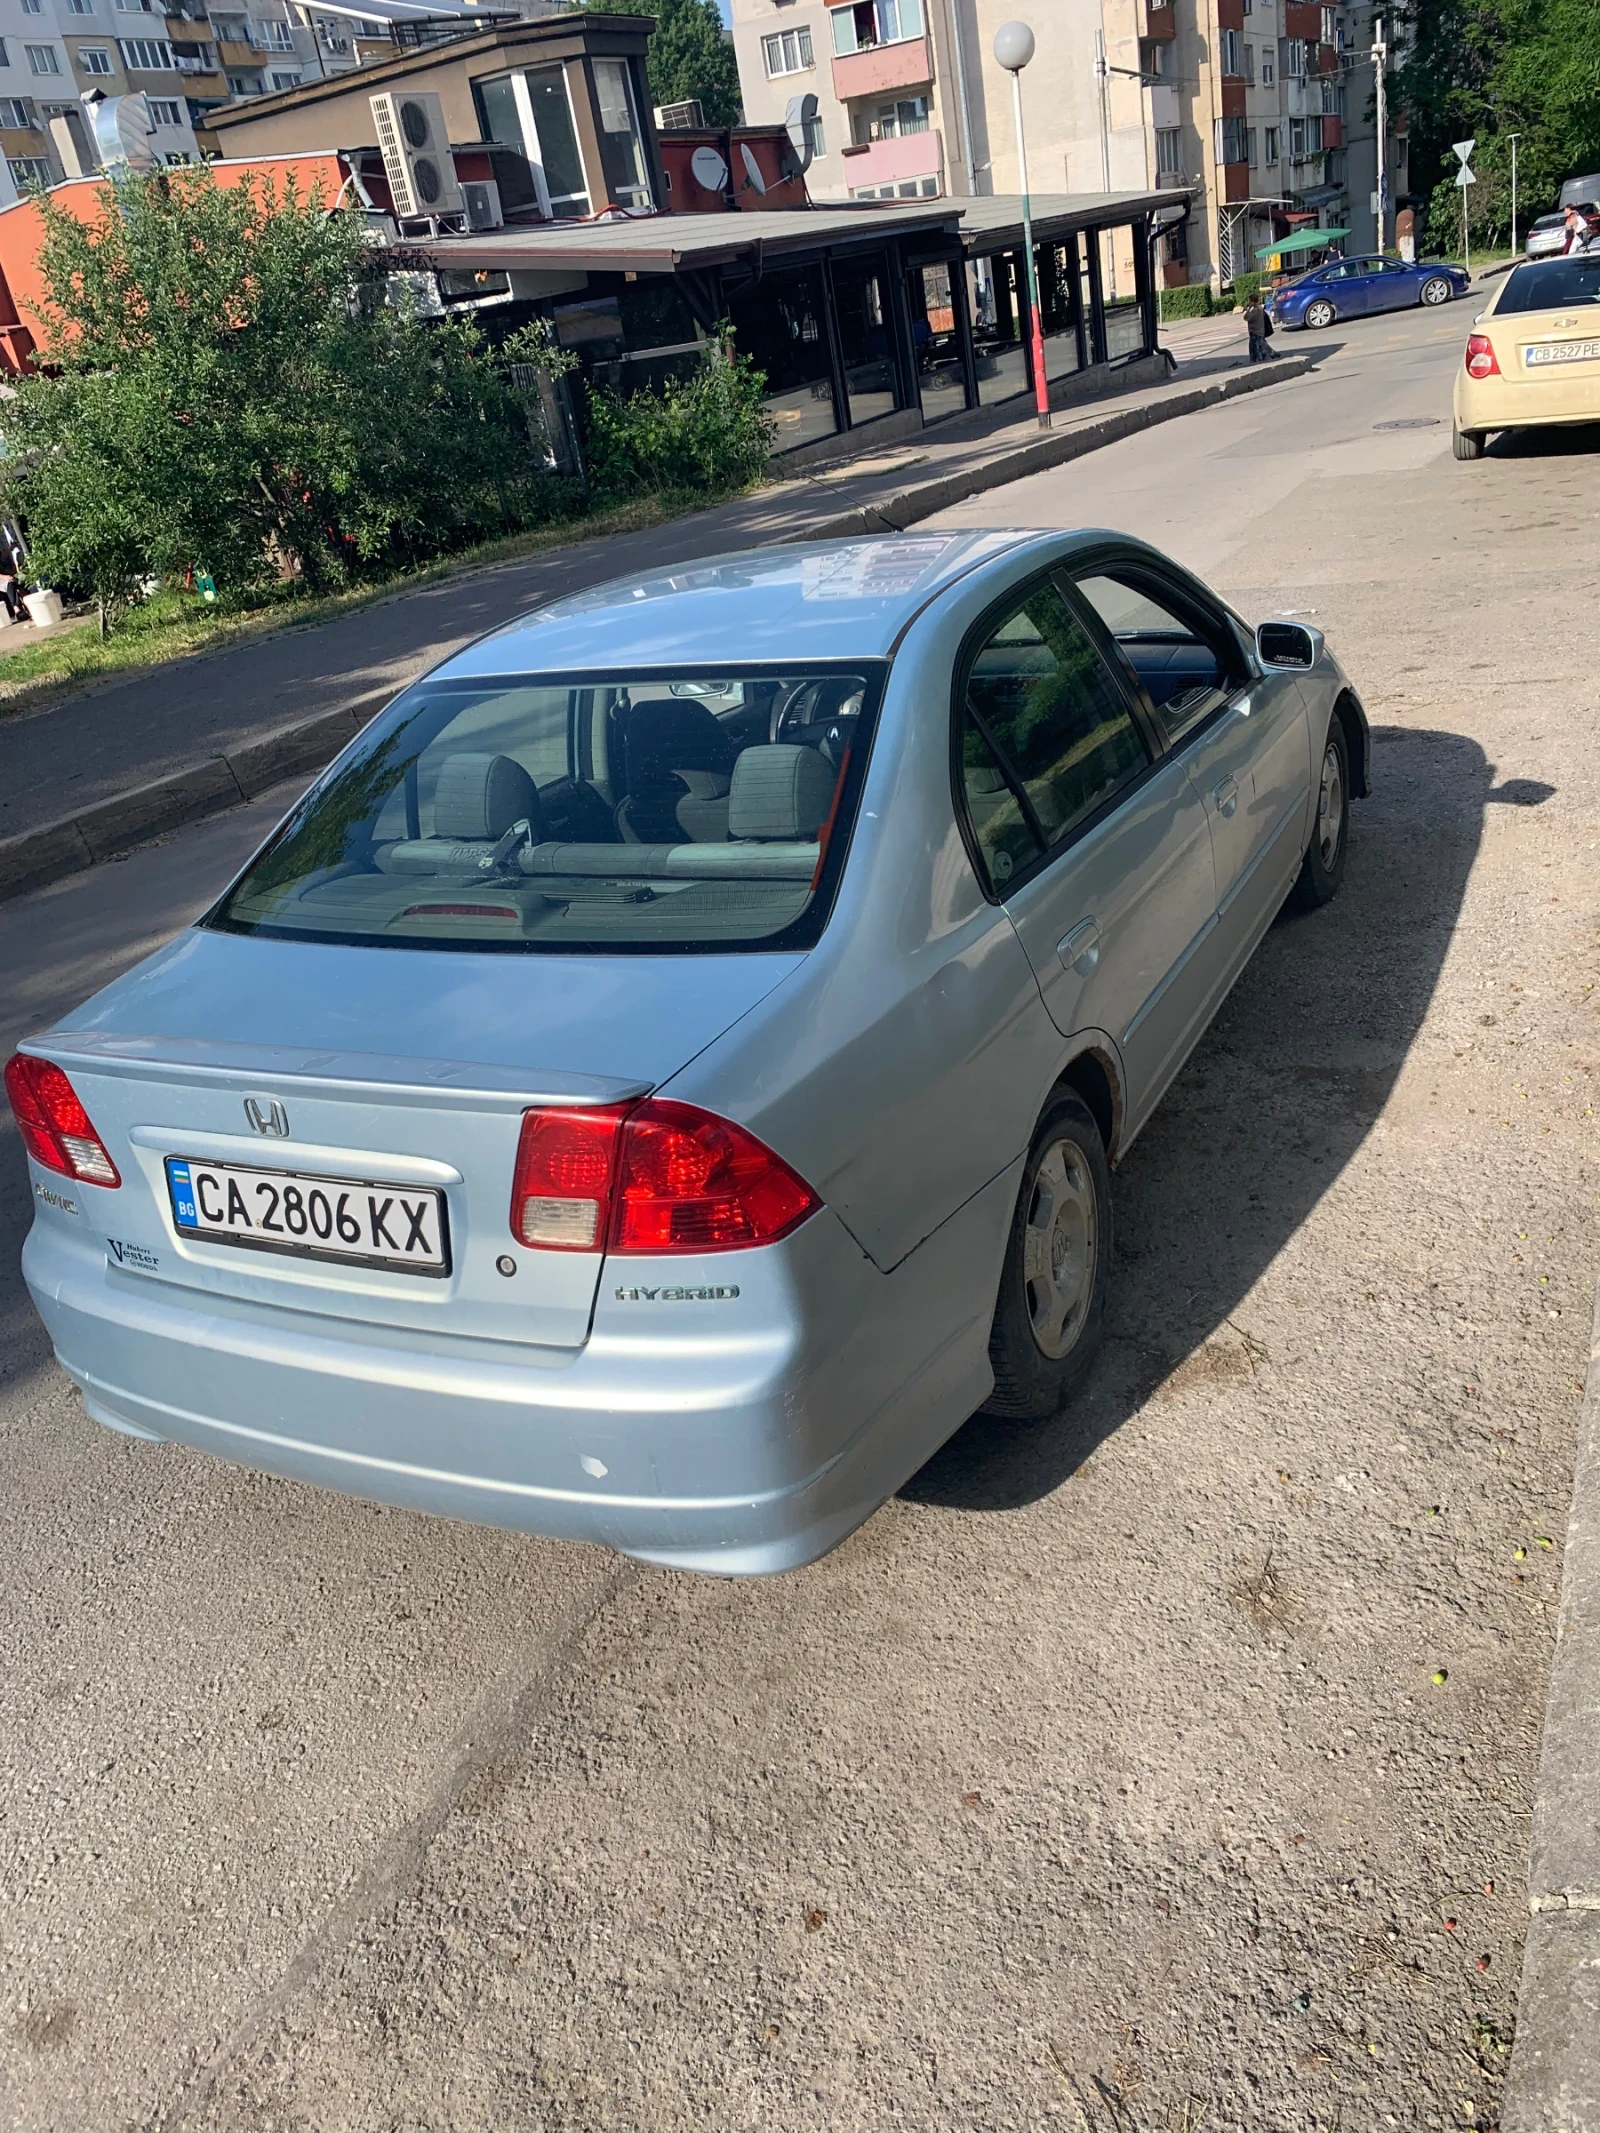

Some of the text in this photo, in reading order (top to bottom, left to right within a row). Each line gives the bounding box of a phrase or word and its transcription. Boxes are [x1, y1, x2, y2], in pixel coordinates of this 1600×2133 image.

[1552, 345, 1582, 360] 2527
[178, 1201, 195, 1217] BG
[106, 1237, 160, 1265] Vester
[614, 1284, 740, 1301] HYBRID
